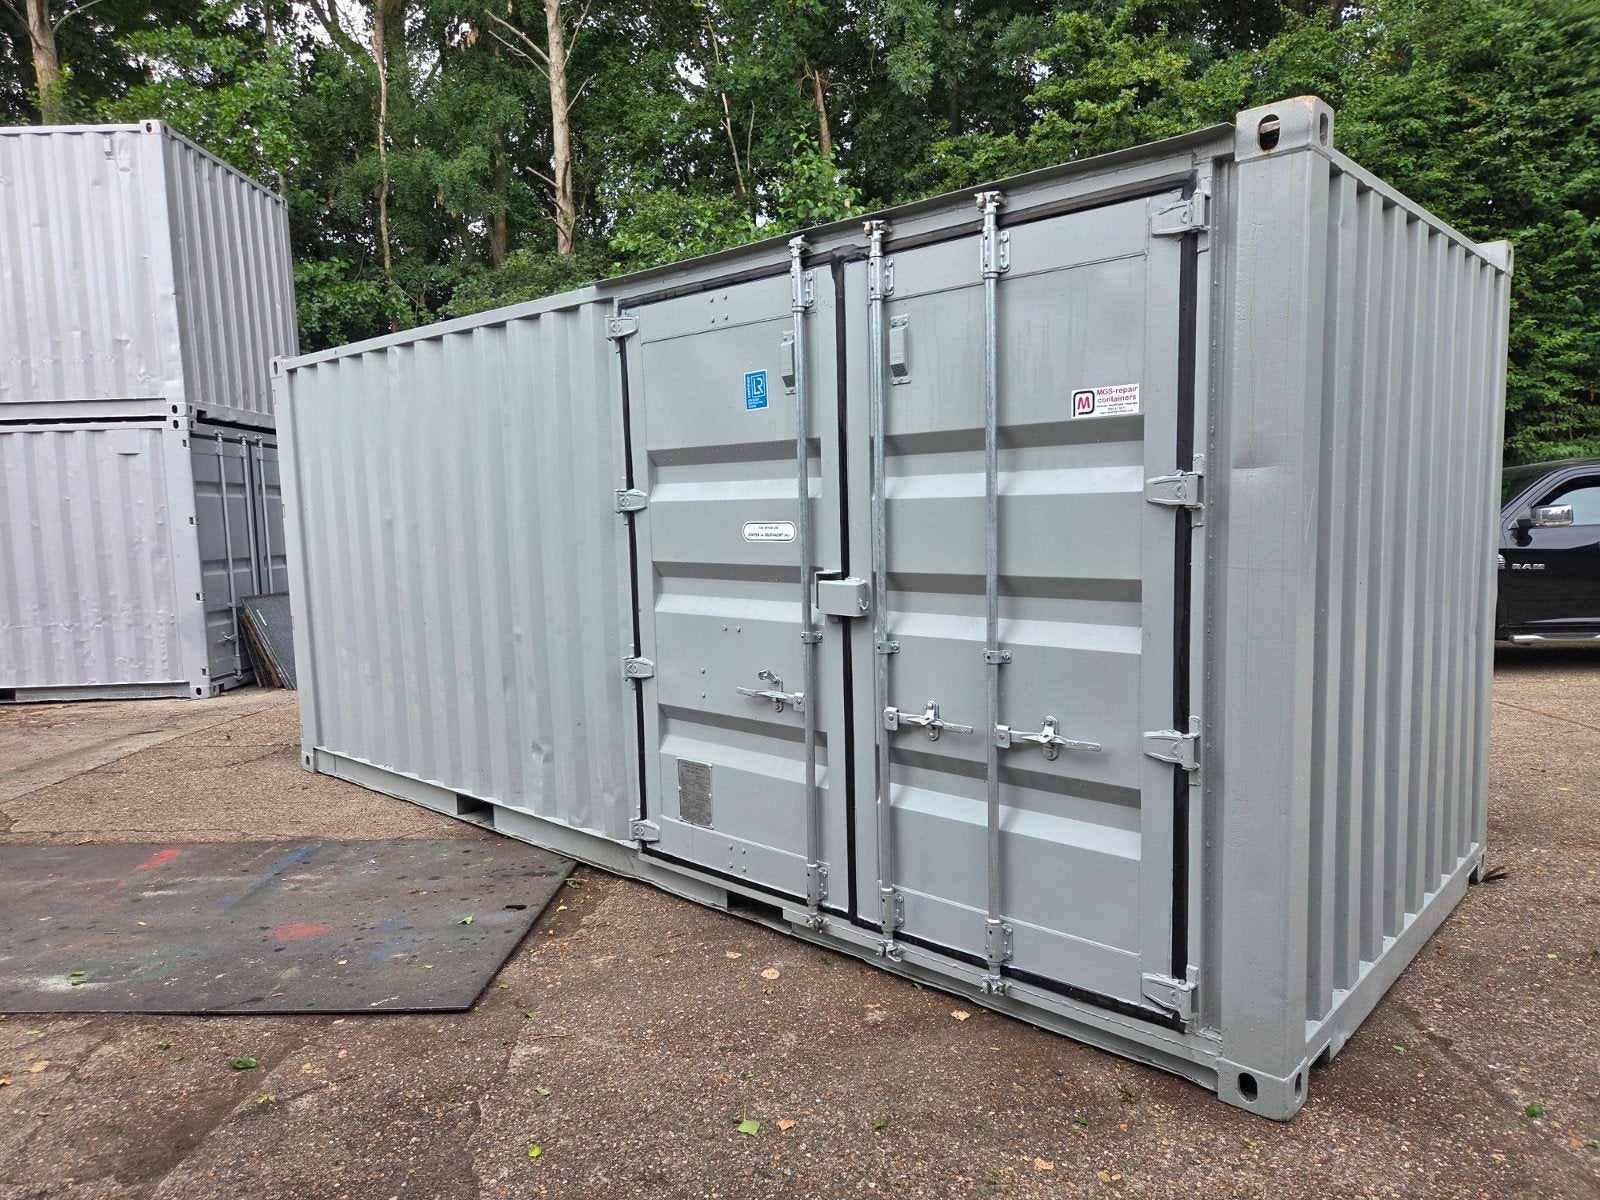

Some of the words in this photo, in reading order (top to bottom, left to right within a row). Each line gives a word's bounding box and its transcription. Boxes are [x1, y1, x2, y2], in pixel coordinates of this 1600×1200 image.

[753, 377, 764, 395] LR
[1096, 386, 1138, 396] MGS-repair
[1077, 396, 1091, 410] M
[1097, 394, 1137, 404] containers
